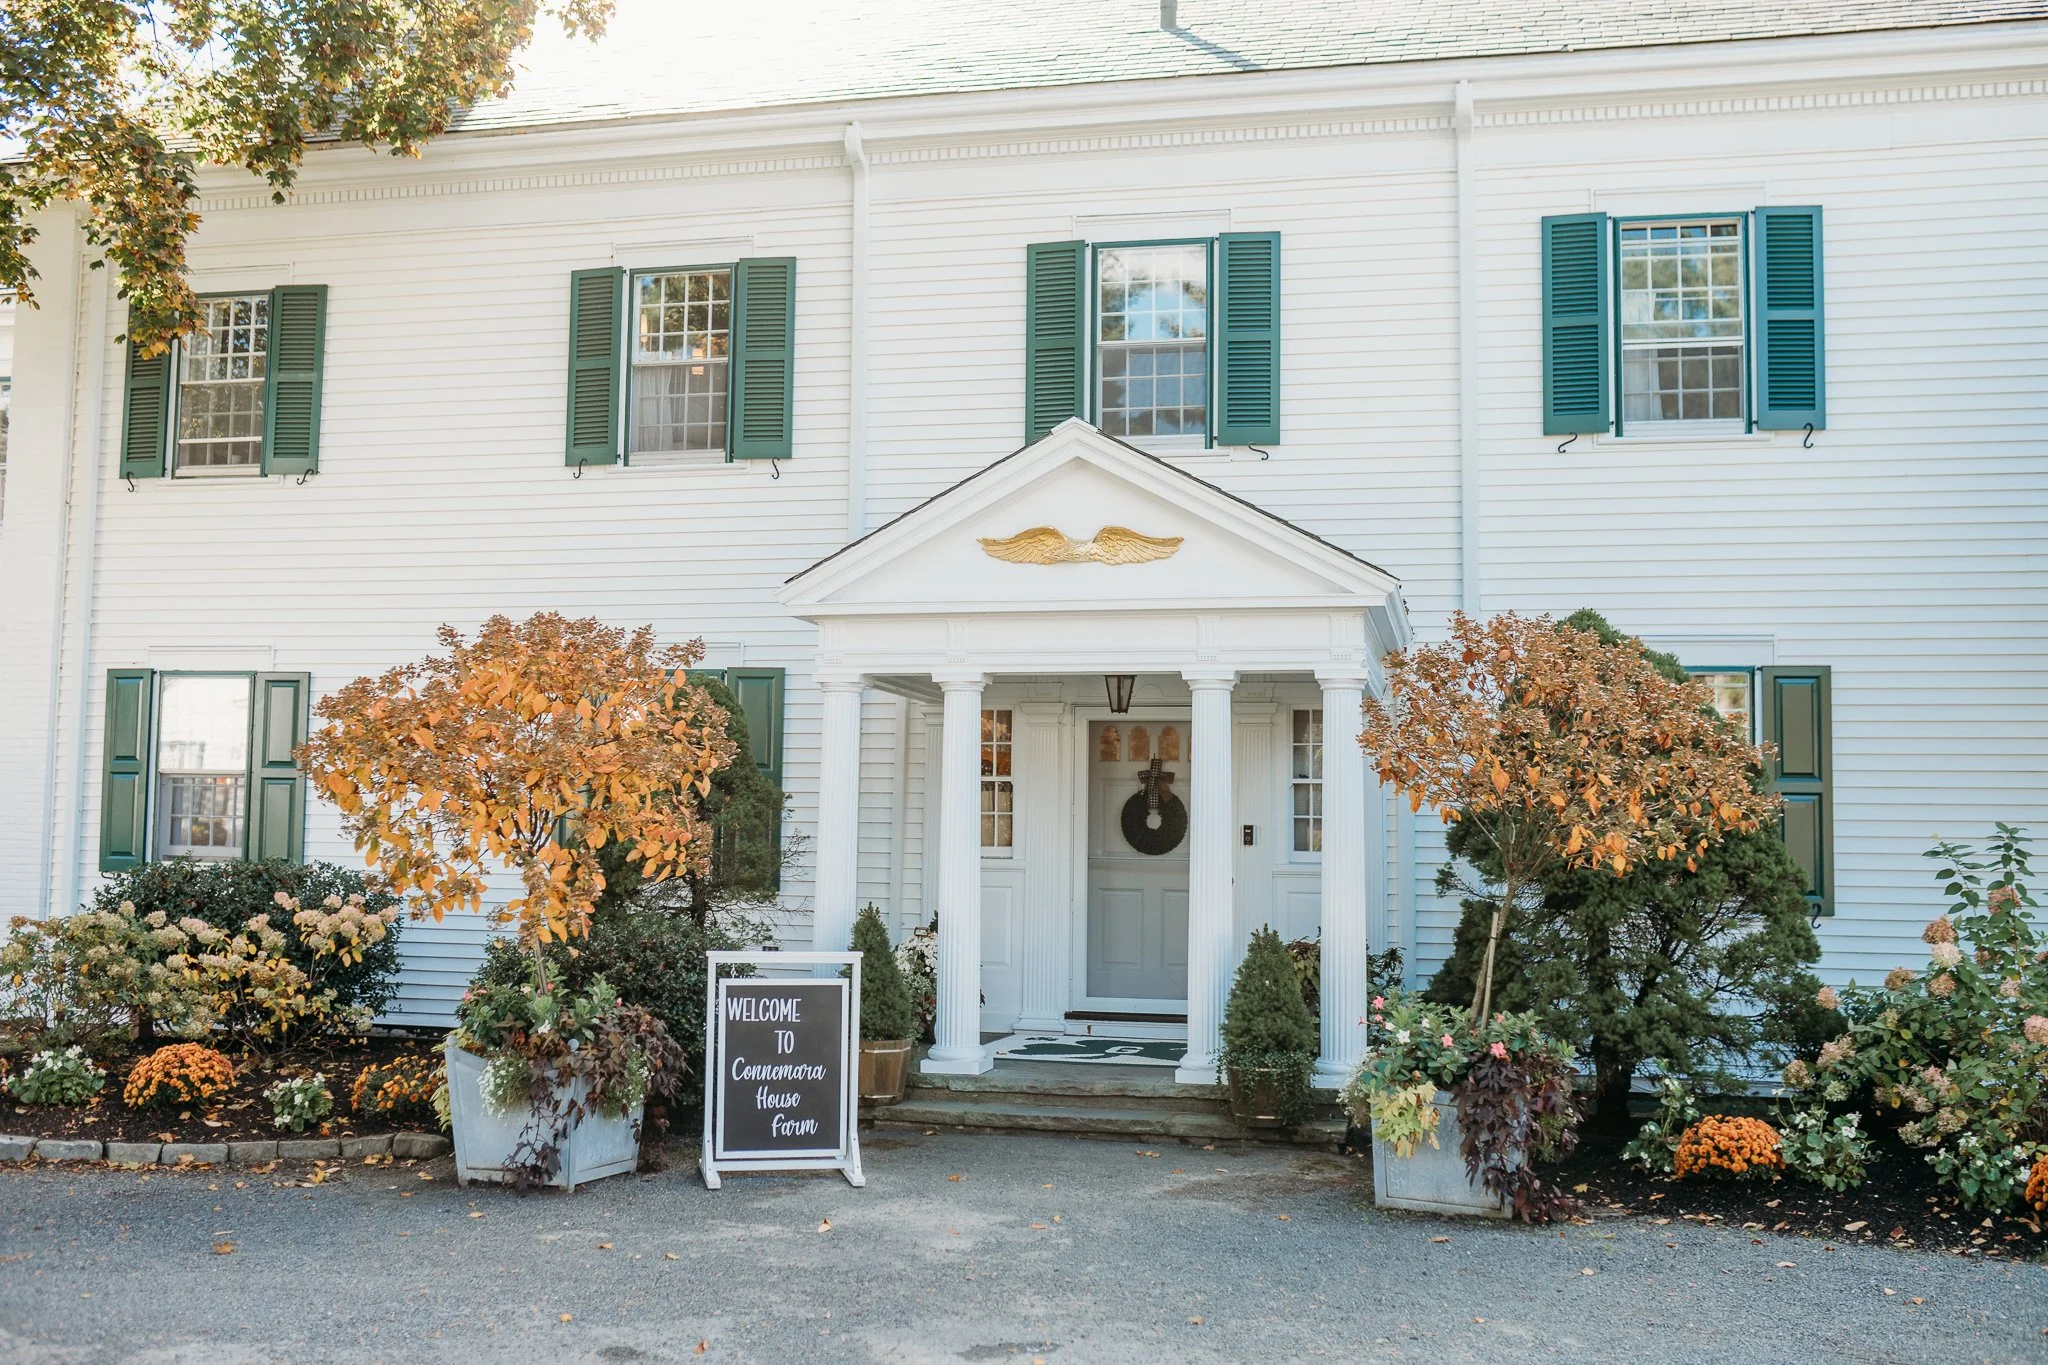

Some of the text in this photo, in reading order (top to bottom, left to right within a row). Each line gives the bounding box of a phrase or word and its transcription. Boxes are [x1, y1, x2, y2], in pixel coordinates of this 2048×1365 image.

[727, 997, 802, 1023] WELCOME
[774, 1030, 795, 1054] TO
[731, 1057, 827, 1081] Connemara
[756, 1085, 801, 1110] House
[771, 1113, 819, 1138] Farm
